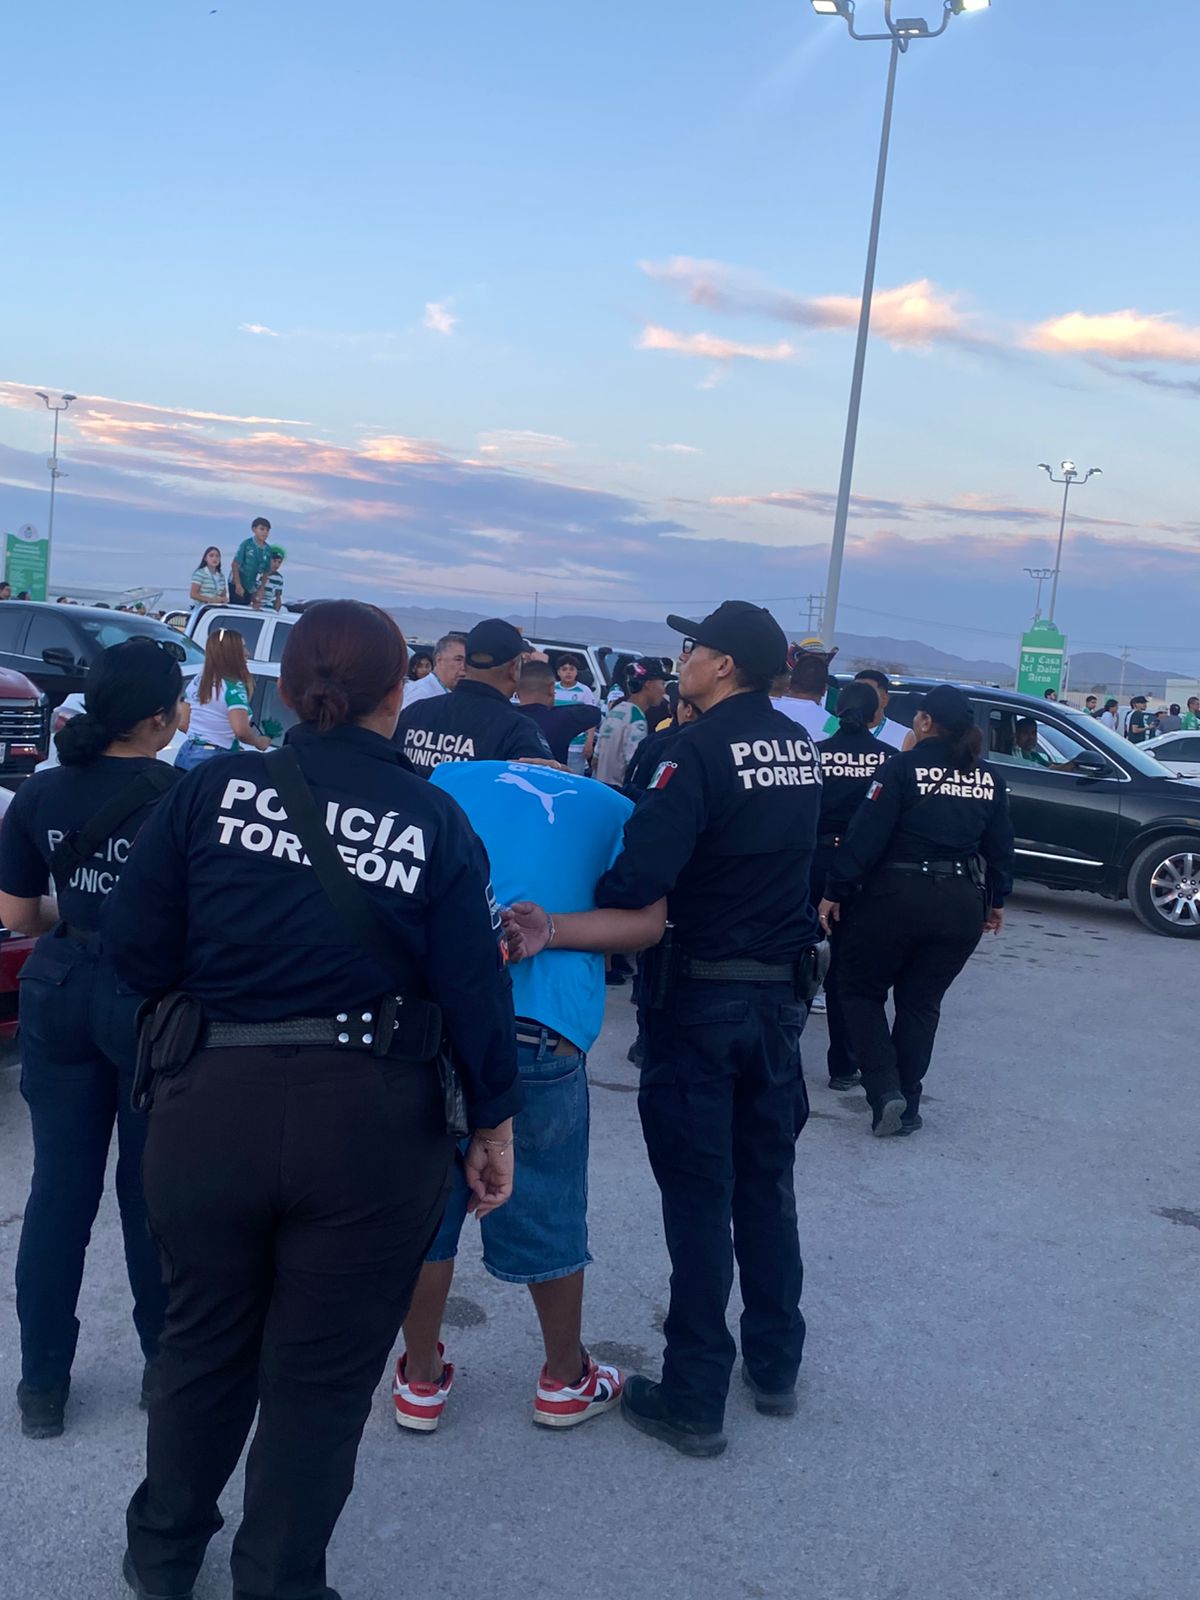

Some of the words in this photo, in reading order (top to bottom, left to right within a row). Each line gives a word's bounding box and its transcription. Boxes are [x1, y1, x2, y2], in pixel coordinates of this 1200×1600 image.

[1038, 655, 1060, 665] Casa
[404, 728, 475, 757] POLICÍA
[730, 736, 821, 766] POLICÍ
[821, 751, 886, 766] POLICÍ
[822, 765, 876, 778] TORRE
[738, 762, 823, 789] TORREÓ
[220, 778, 426, 862] POICÍA
[217, 815, 421, 894] TOREÓN
